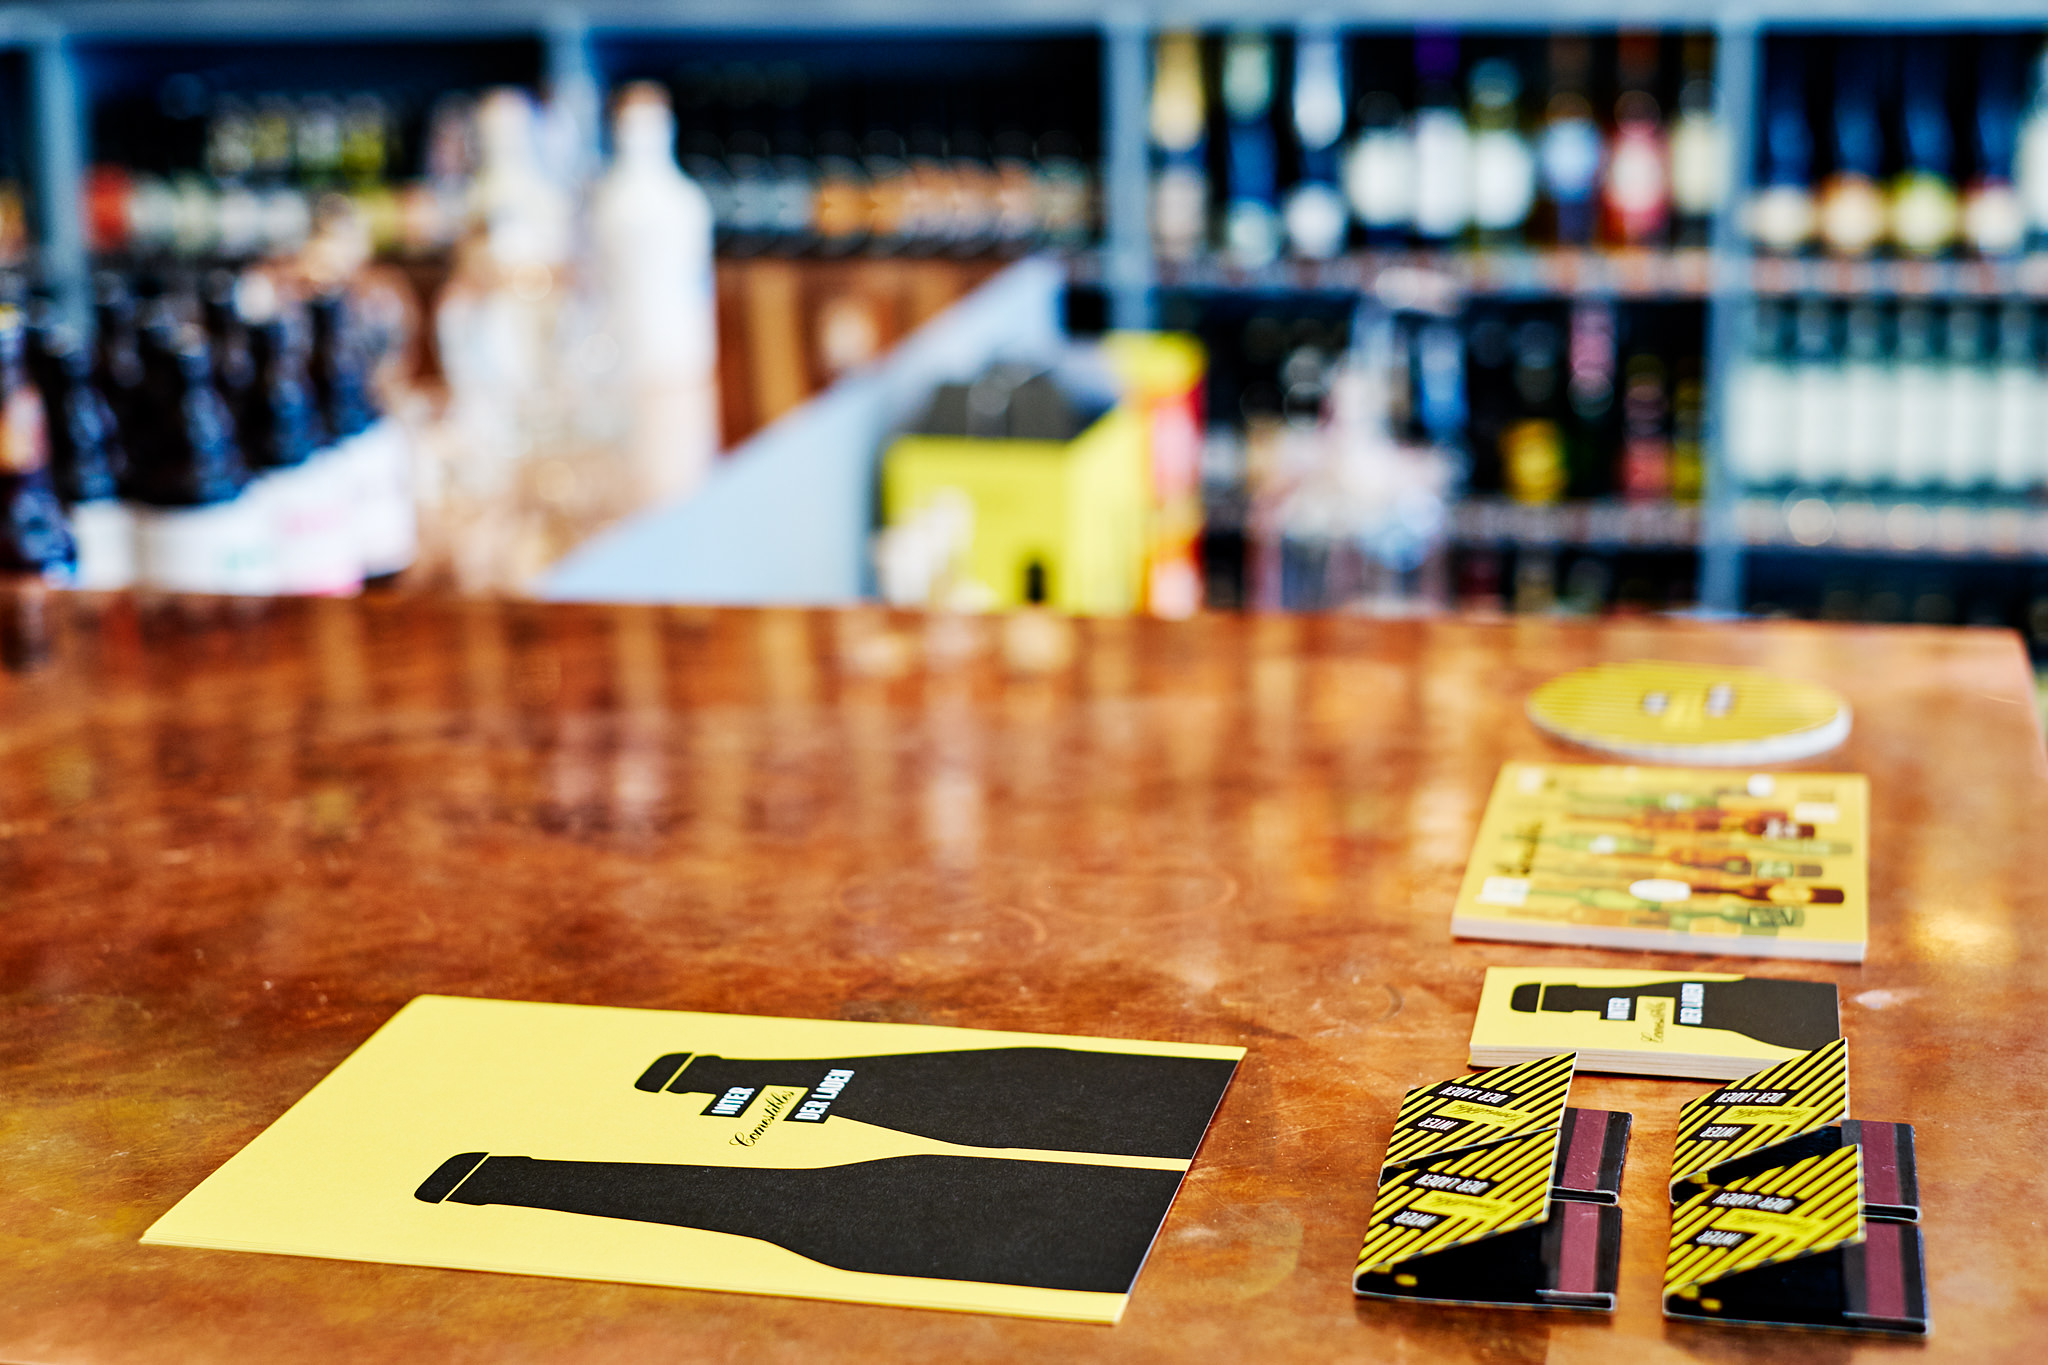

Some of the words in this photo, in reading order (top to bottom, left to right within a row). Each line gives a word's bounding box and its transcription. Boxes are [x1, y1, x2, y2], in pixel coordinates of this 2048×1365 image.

[811, 1069, 855, 1100] LADEN
[1439, 1085, 1483, 1100] LADEN
[711, 1087, 755, 1115] INTER
[1481, 1091, 1508, 1103] DER
[1714, 1091, 1756, 1104] LADEN
[1755, 1092, 1787, 1103] DER
[729, 1090, 795, 1147] Comestibles
[795, 1101, 831, 1120] DER
[1418, 1117, 1458, 1131] INTER
[1699, 1126, 1742, 1138] INTER
[1414, 1173, 1461, 1190] LADEN
[1456, 1178, 1489, 1194] DER
[1712, 1192, 1763, 1208] LADEN
[1757, 1197, 1795, 1213] DER
[1393, 1210, 1439, 1228] INTER
